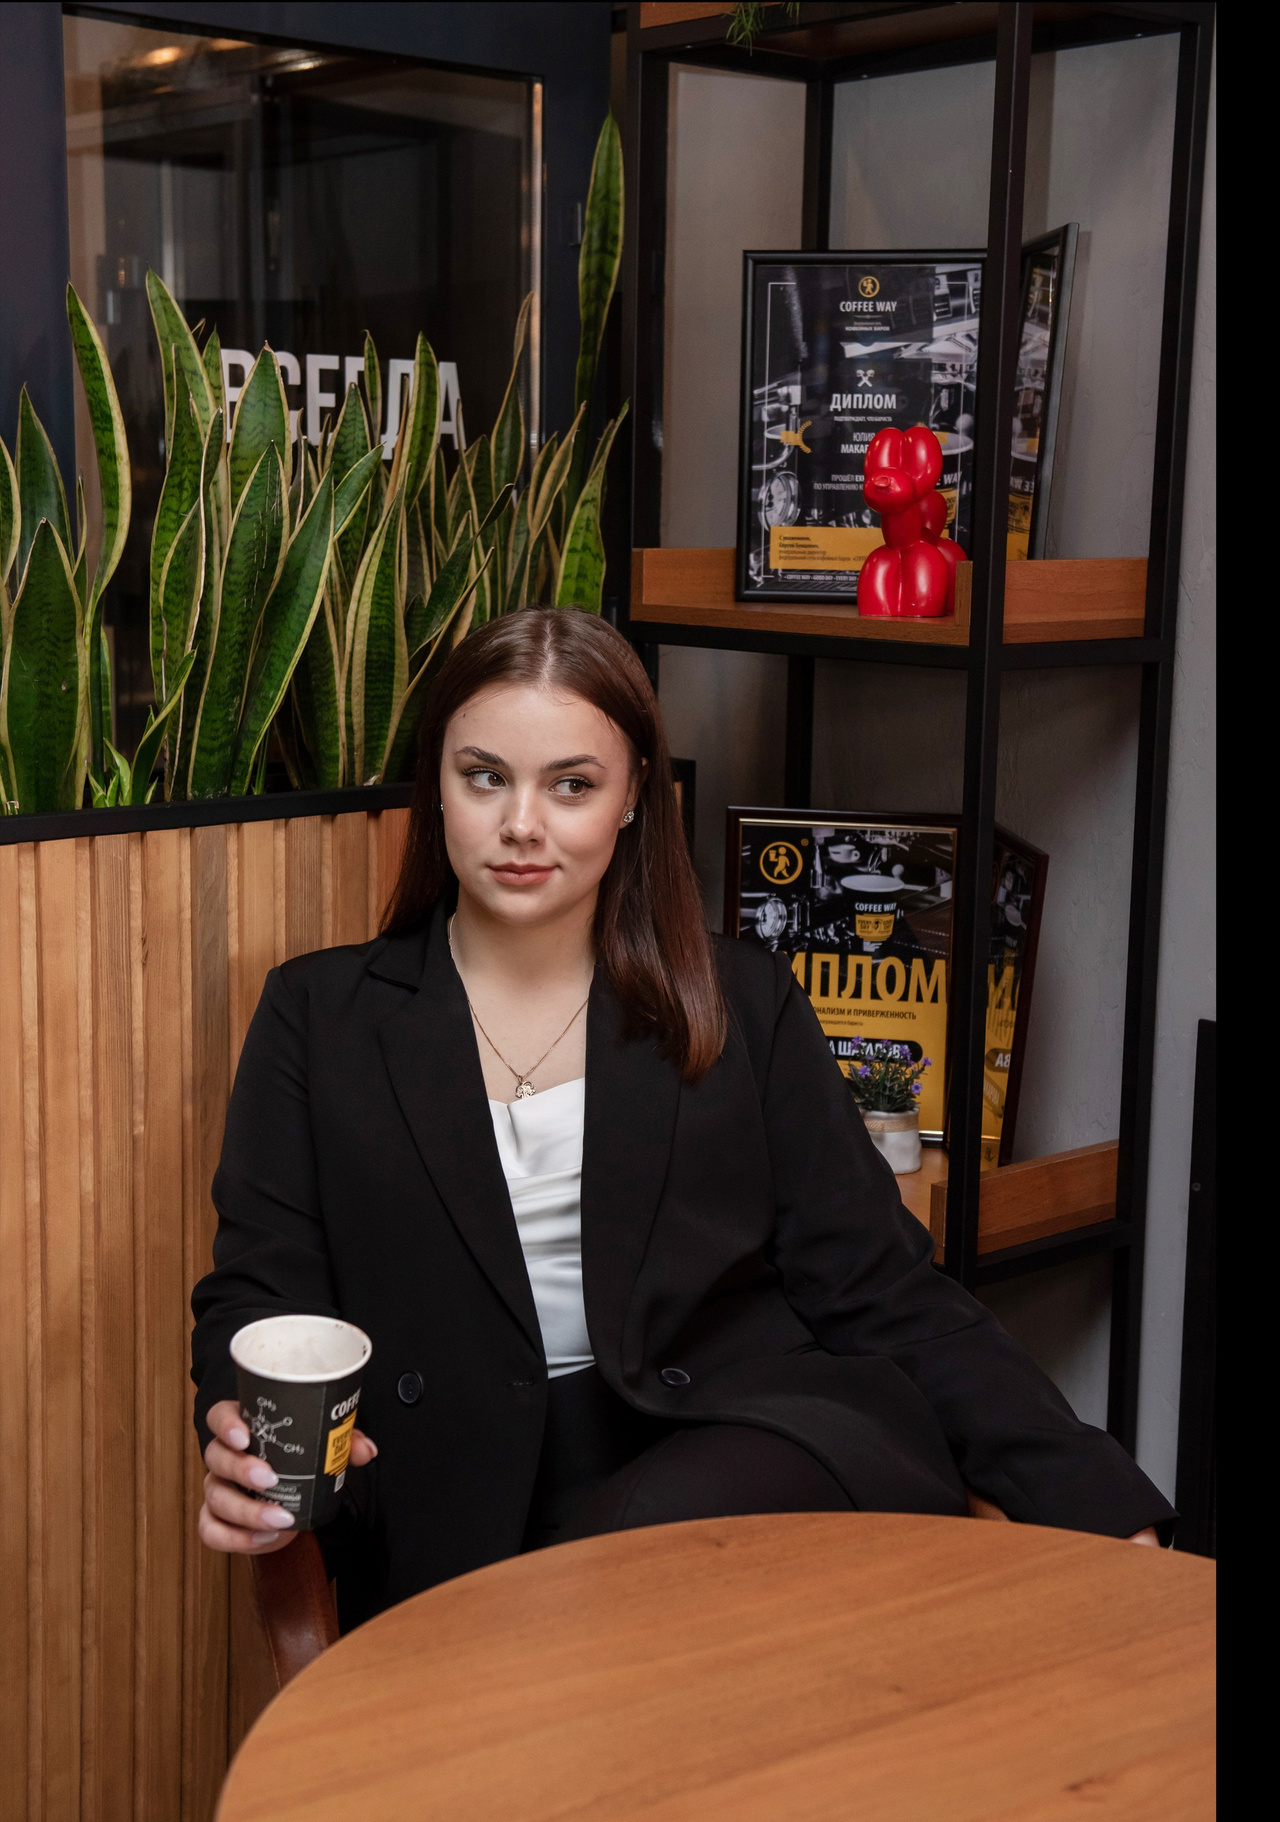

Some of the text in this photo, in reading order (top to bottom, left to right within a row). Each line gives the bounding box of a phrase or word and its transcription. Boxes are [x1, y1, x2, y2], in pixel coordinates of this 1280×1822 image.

[839, 301, 898, 312] COFFEE WAY
[829, 393, 897, 411] ДИПЛОМ
[855, 902, 897, 912] COFFEE WAY
[783, 951, 948, 1003] ИПЛОМ
[853, 1008, 917, 1020] ПРИВЕРЖЕННОСТЬ
